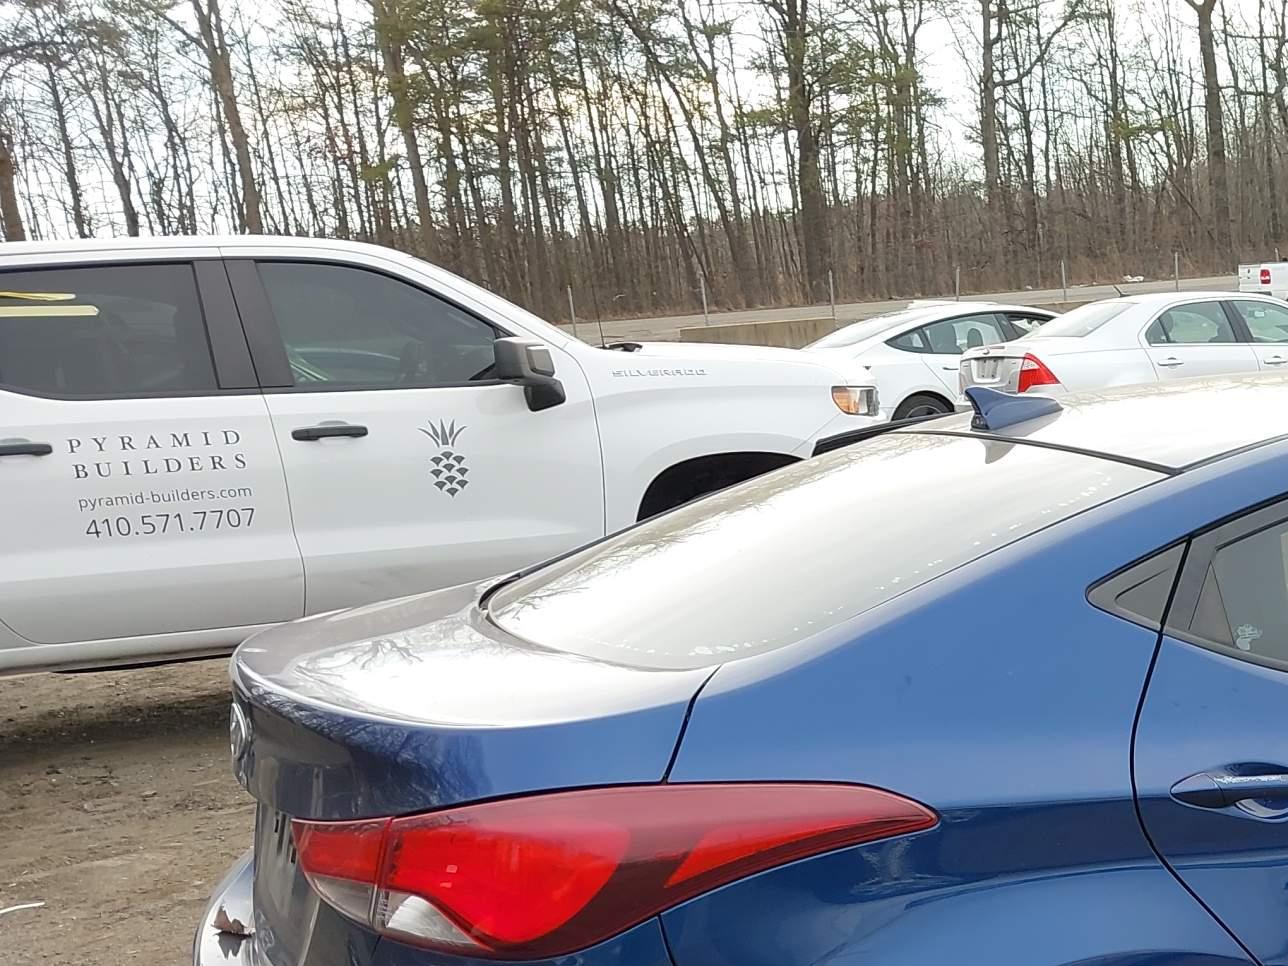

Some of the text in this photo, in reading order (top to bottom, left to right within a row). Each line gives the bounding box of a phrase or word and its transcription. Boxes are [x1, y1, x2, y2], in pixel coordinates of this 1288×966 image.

[66, 429, 241, 454] PYRAMID
[72, 453, 247, 479] BUILDERS
[78, 486, 253, 512] pyramid-builders.com
[85, 507, 255, 539] 410.571.7707
